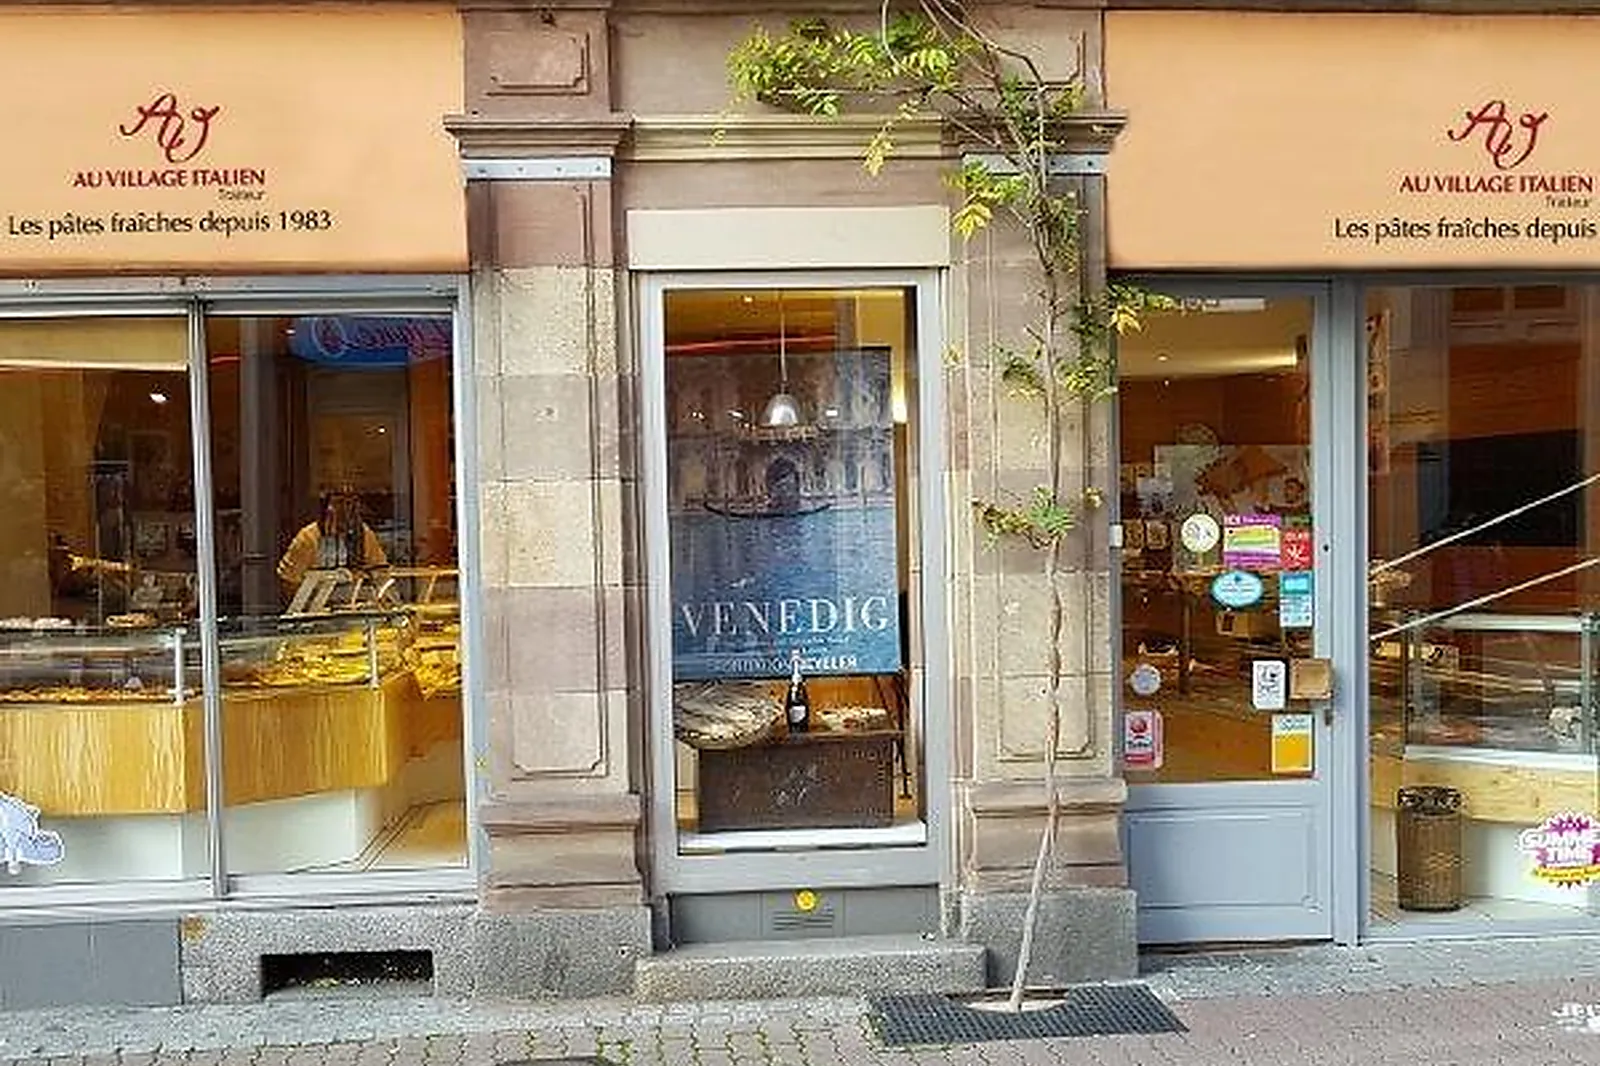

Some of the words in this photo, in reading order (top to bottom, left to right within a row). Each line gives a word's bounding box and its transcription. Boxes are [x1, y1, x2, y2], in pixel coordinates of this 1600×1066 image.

[73, 172, 103, 188] AU
[105, 170, 188, 187] VILLAGE
[192, 168, 266, 186] ITALIEN
[1399, 176, 1430, 193] AU
[1434, 175, 1514, 193] VILLAGE
[1519, 175, 1593, 193] ITALIEN
[9, 216, 43, 235] Les
[49, 212, 105, 240] pâtes
[110, 211, 193, 234] fraîches
[198, 210, 271, 238] depuis
[278, 210, 332, 231] 1983
[1335, 217, 1369, 238] Les
[1375, 217, 1431, 245] pâtes
[1437, 216, 1521, 239] fraîches
[1525, 215, 1598, 245] depuis
[681, 595, 889, 637] VENEDIG
